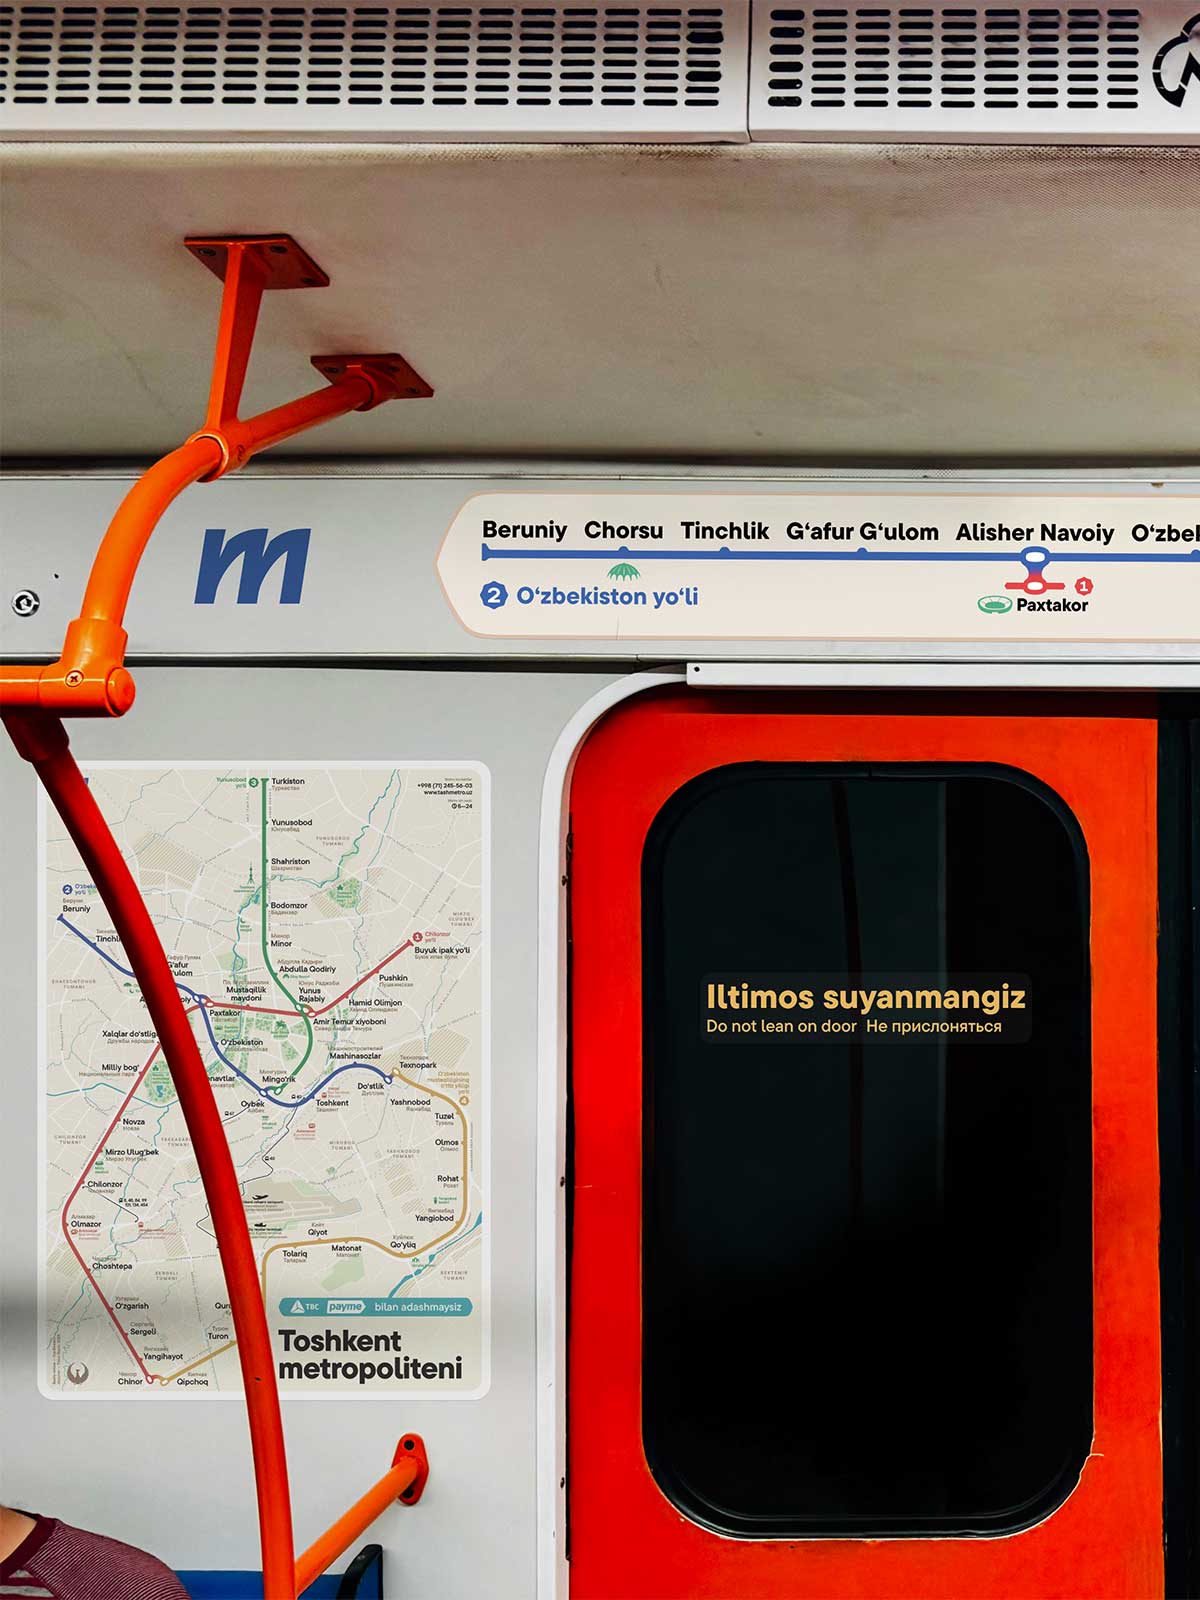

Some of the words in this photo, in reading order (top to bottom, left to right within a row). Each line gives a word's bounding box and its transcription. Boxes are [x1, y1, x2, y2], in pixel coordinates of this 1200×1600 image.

[482, 520, 567, 542] Beruniy
[584, 521, 663, 539] Chorsu
[681, 521, 769, 540] Tinchlik
[786, 522, 854, 541] G‘afur
[859, 522, 939, 541] G‘ulom
[956, 523, 1034, 542] Alisher
[1040, 523, 1114, 546] Navoiy
[486, 586, 501, 604] 2
[516, 586, 647, 605] O‘zbekiston
[653, 587, 699, 609] yo‘li
[1016, 598, 1089, 612] Paxtakor
[271, 777, 305, 785] Turkiston
[432, 782, 443, 790] (71)
[62, 905, 91, 913] Beruniy
[414, 946, 437, 955] Buyuk
[438, 946, 454, 955] ipak
[279, 965, 308, 973] Abdulla
[309, 965, 337, 974] Qodiriy
[226, 986, 267, 994] Mustaqillik
[298, 995, 325, 1003] Rajabiy
[707, 983, 814, 1010] Iltimos
[823, 983, 1026, 1016] suyanmangiz
[374, 1000, 403, 1008] Olimjon
[209, 1009, 241, 1017] Paxtakor
[355, 1018, 387, 1026] xiyoboni
[706, 1019, 728, 1033] Do
[731, 1020, 756, 1033] not
[761, 1019, 794, 1033] lean
[797, 1022, 817, 1033] on
[821, 1019, 858, 1033] door
[866, 1019, 888, 1033] Не
[892, 1022, 1002, 1035] прислоняться
[102, 1030, 128, 1039] Xalqlar
[102, 1063, 122, 1072] Milliy
[399, 1062, 437, 1070] Texnopark
[240, 1100, 265, 1108] Oybek
[316, 1099, 349, 1107] Toshkent
[390, 1098, 431, 1106] Yashnobod
[434, 1112, 455, 1120] Tuzel
[122, 1118, 146, 1126] Novza
[434, 1138, 459, 1146] Olmos
[437, 1174, 459, 1182] Rohat
[415, 1214, 454, 1223] Yangiobod
[70, 1220, 102, 1228] Olmazor
[307, 1228, 328, 1237] Qiyot
[331, 1244, 362, 1252] Matonat
[282, 1250, 308, 1259] Tolariq
[92, 1262, 133, 1271] Choshtepa
[305, 1303, 320, 1311] TBC
[328, 1302, 362, 1313] payme
[374, 1302, 399, 1312] bilan
[401, 1302, 463, 1313] adashmaysiz
[130, 1328, 157, 1336] Sergeli
[208, 1332, 229, 1340] Turon
[278, 1329, 402, 1352] Toshkent
[143, 1352, 183, 1361] Yangihayot
[279, 1355, 463, 1385] metropoliteni
[176, 1378, 209, 1387] Qipchoq
